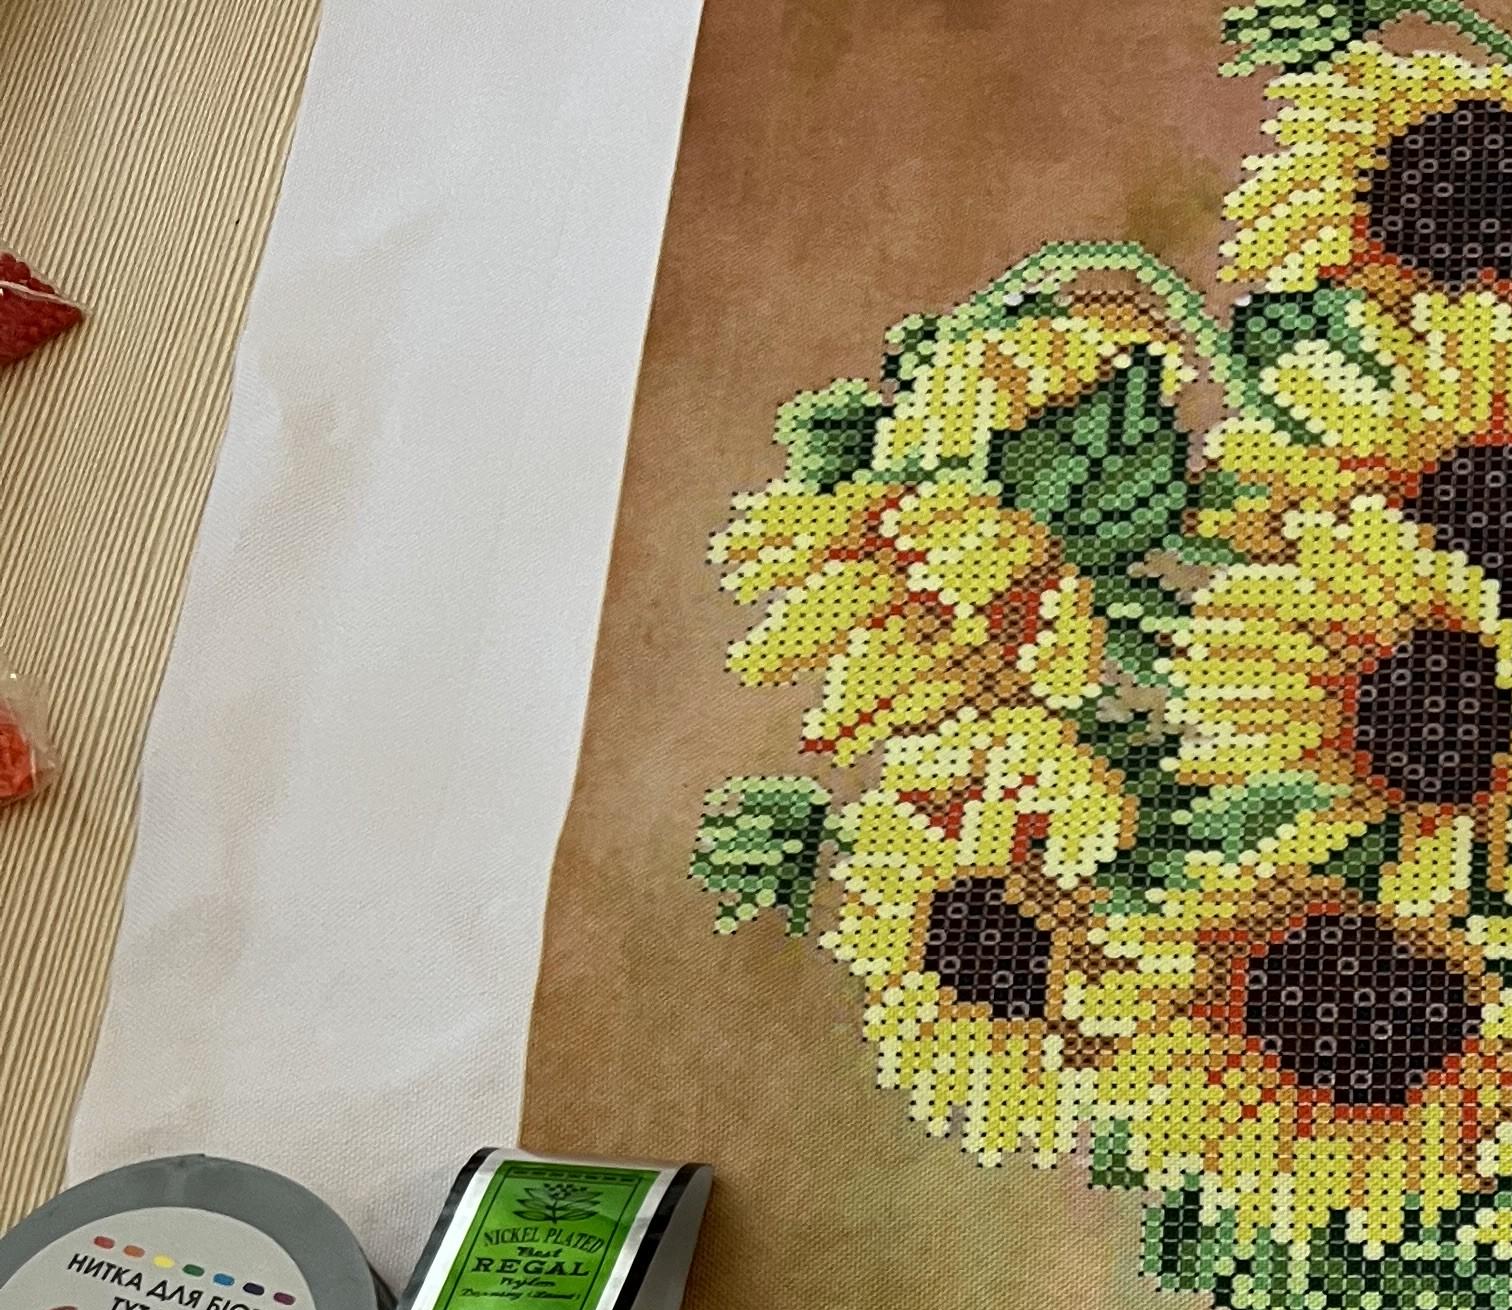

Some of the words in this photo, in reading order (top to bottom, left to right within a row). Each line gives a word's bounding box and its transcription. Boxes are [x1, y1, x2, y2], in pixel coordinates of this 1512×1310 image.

[483, 1227, 541, 1247] NICKEL
[542, 1227, 605, 1254] PLATED
[471, 1257, 589, 1276] REGAL
[67, 1253, 143, 1291] НИТКА
[146, 1279, 203, 1310] ДЛЯ
